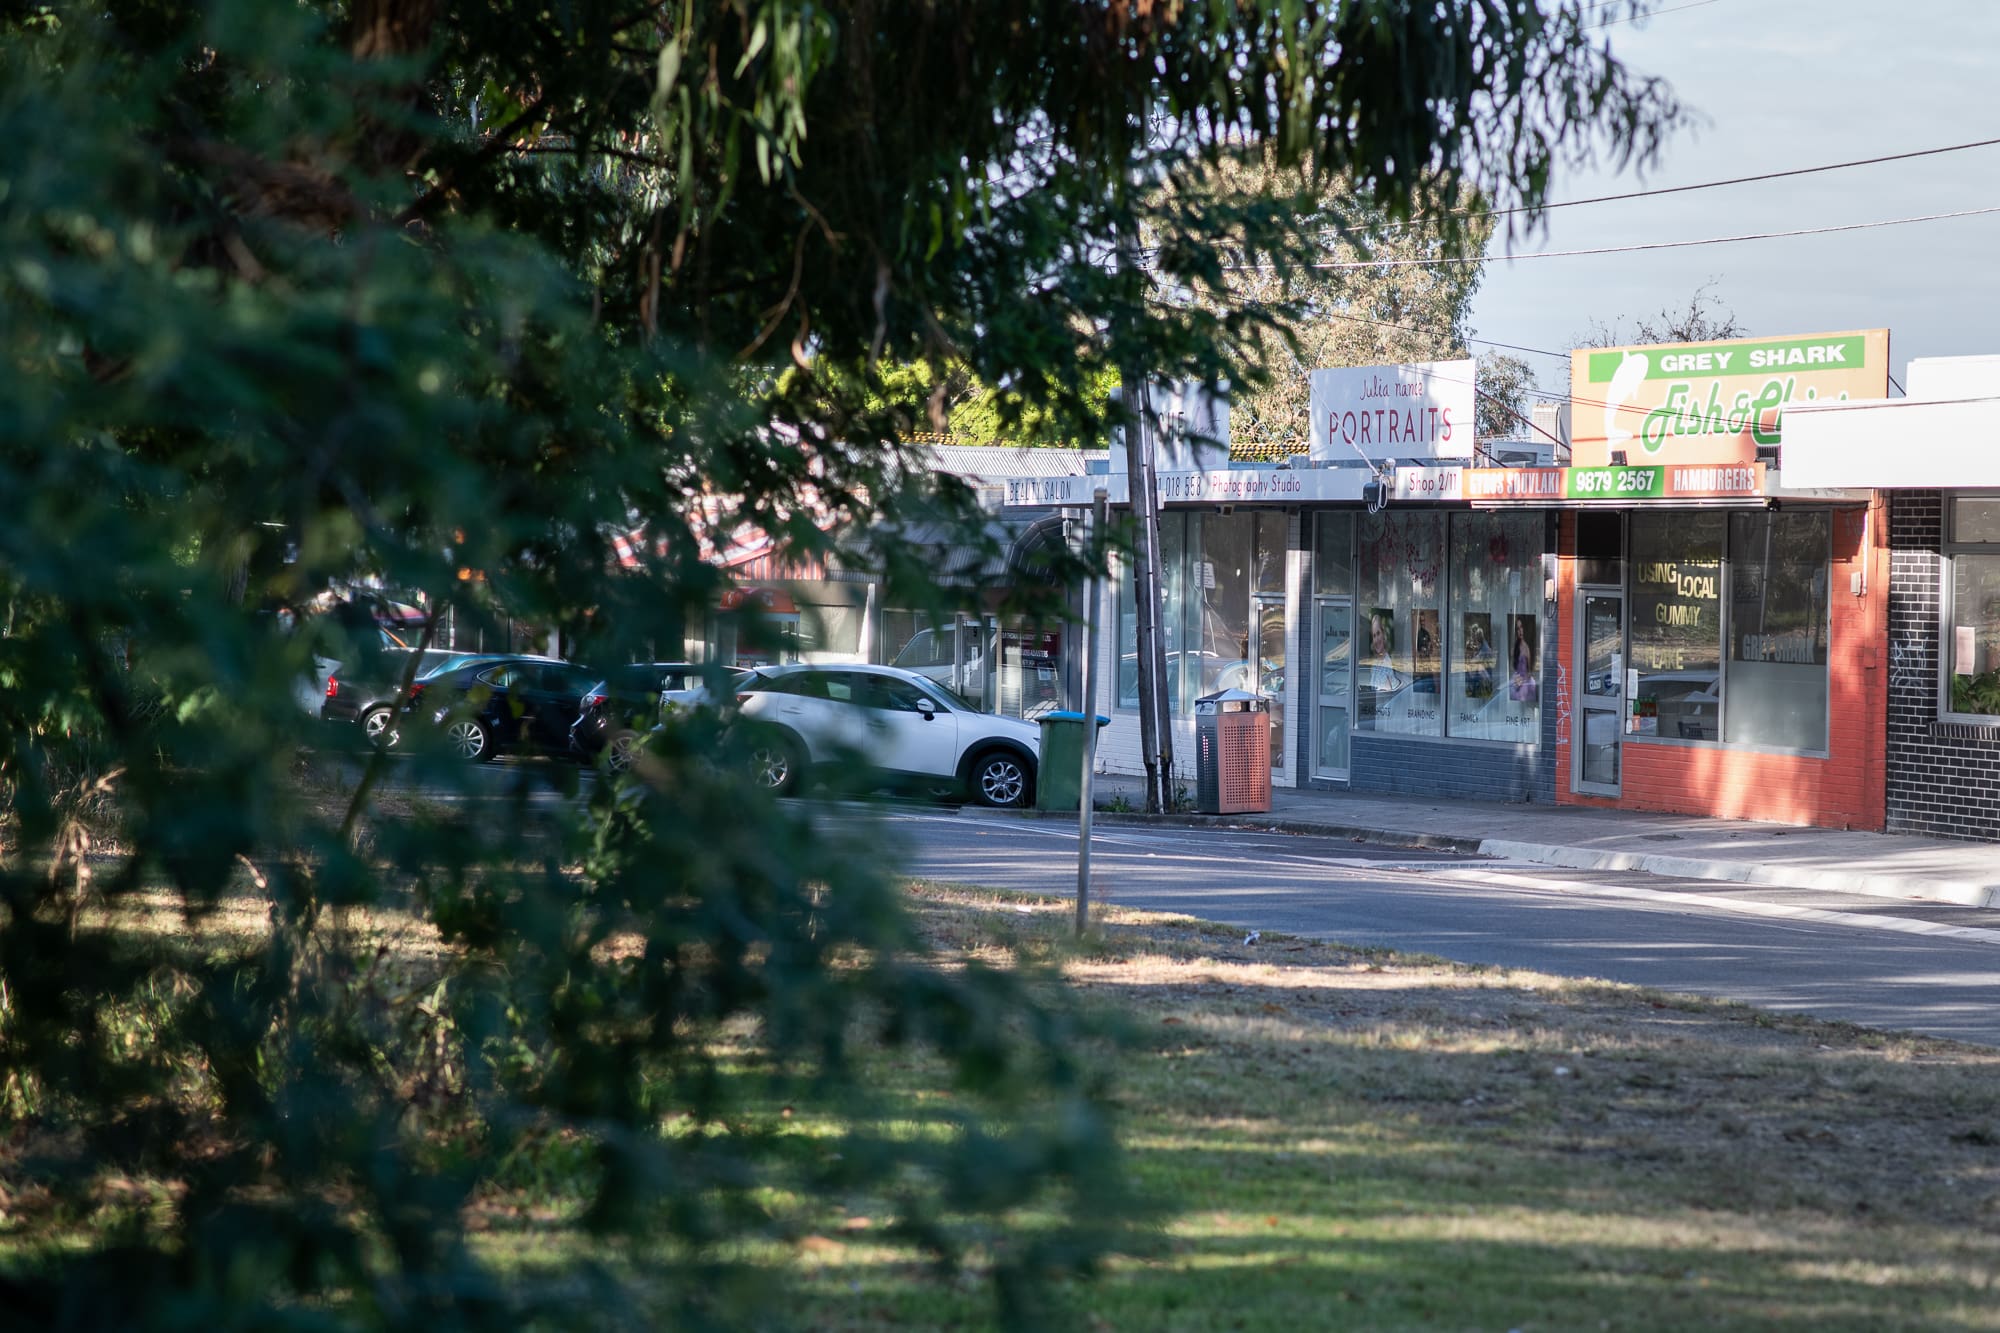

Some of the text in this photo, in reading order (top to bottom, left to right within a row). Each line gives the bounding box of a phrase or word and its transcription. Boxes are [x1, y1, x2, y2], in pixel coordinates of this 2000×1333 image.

[1660, 343, 1846, 373] GREY SHARK
[1360, 375, 1390, 400] Julia
[1329, 407, 1452, 445] PORTRAITS
[1642, 381, 1725, 453] Fish
[1009, 480, 1071, 501] BEAUTY SALON
[1165, 477, 1180, 497] 018
[1212, 472, 1301, 497] Photography Studio
[1409, 472, 1457, 495] Shop 2/11
[1506, 472, 1559, 494] SOUVLAKI
[1575, 470, 1655, 492] 9879 2567
[1673, 468, 1755, 492] HAMBURGERS
[1638, 562, 1677, 584] USING
[1677, 573, 1718, 600] LOCAL
[1655, 603, 1701, 627] GUMMY
